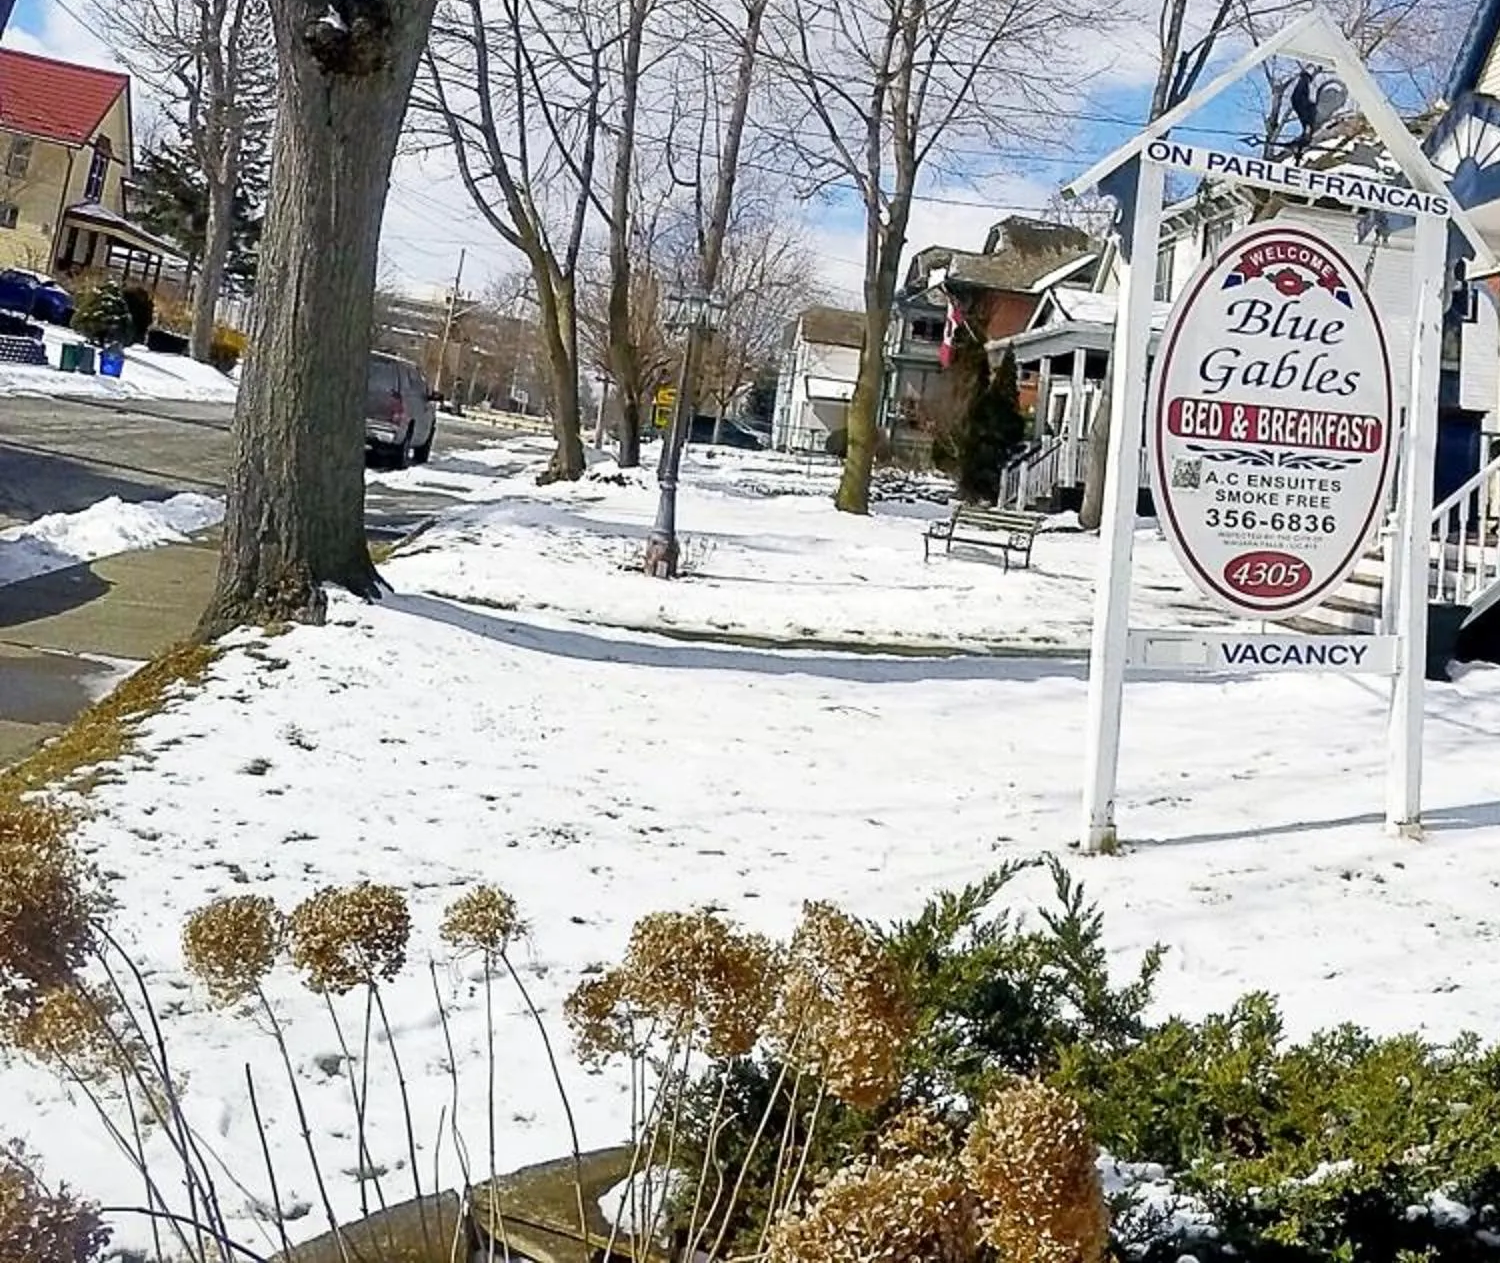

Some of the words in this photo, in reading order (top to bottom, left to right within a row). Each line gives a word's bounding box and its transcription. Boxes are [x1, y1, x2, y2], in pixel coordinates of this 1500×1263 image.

[1148, 142, 1193, 167] ON
[1207, 152, 1300, 186] PARLE
[1309, 173, 1449, 216] FRANCAIS
[1250, 246, 1333, 278] WELCOME
[1226, 299, 1345, 345] Blue
[1199, 347, 1361, 396] Gables
[1180, 401, 1223, 435] BED
[1230, 406, 1249, 439] &
[1257, 408, 1377, 449] BREAKFAST
[1247, 474, 1342, 493] ENSUITES
[1215, 490, 1279, 506] SMOKE
[1285, 494, 1331, 509] FREE
[1205, 508, 1336, 534] 356-6836
[1232, 562, 1305, 587] 4305
[1221, 642, 1369, 665] VACANCY
